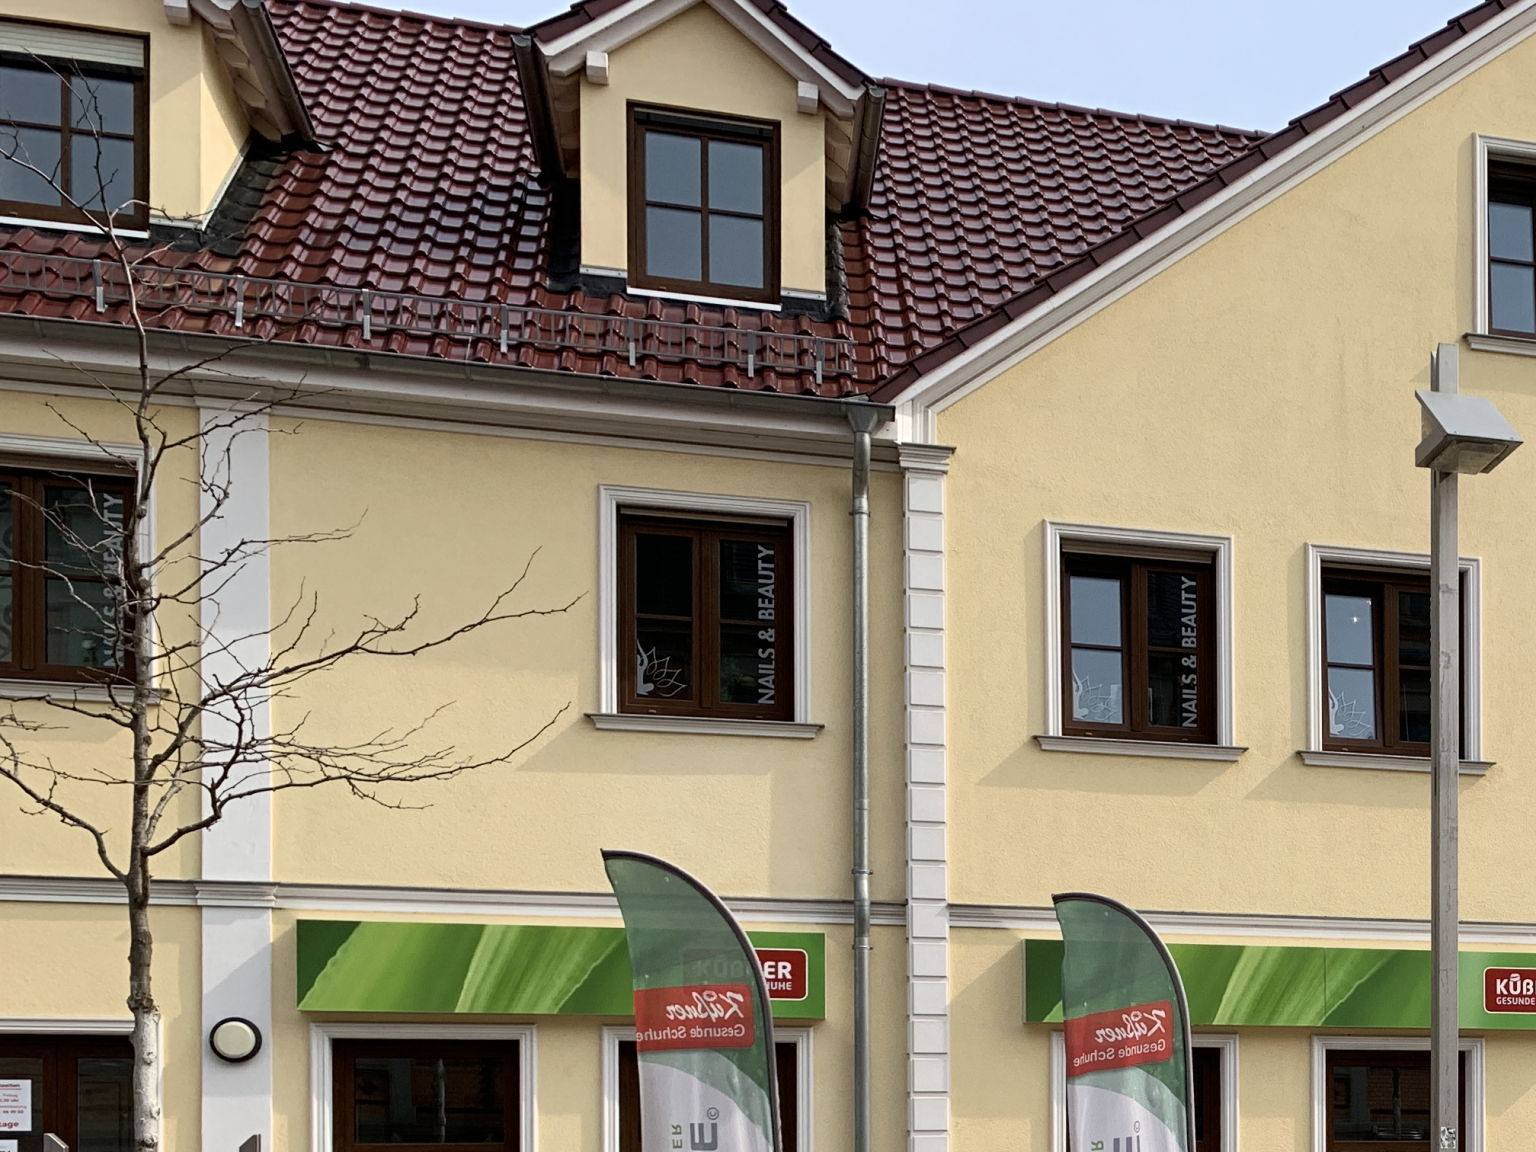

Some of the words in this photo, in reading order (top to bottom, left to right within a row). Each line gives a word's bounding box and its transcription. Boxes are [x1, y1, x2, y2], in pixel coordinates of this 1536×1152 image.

[758, 545, 775, 620] BEAUTY
[758, 628, 775, 642] &
[1181, 576, 1197, 648] BEAUTY
[758, 648, 775, 705] NAILS
[1182, 655, 1197, 668] &
[1182, 674, 1197, 727] NAILS
[1496, 997, 1536, 1005] GESUNDE
